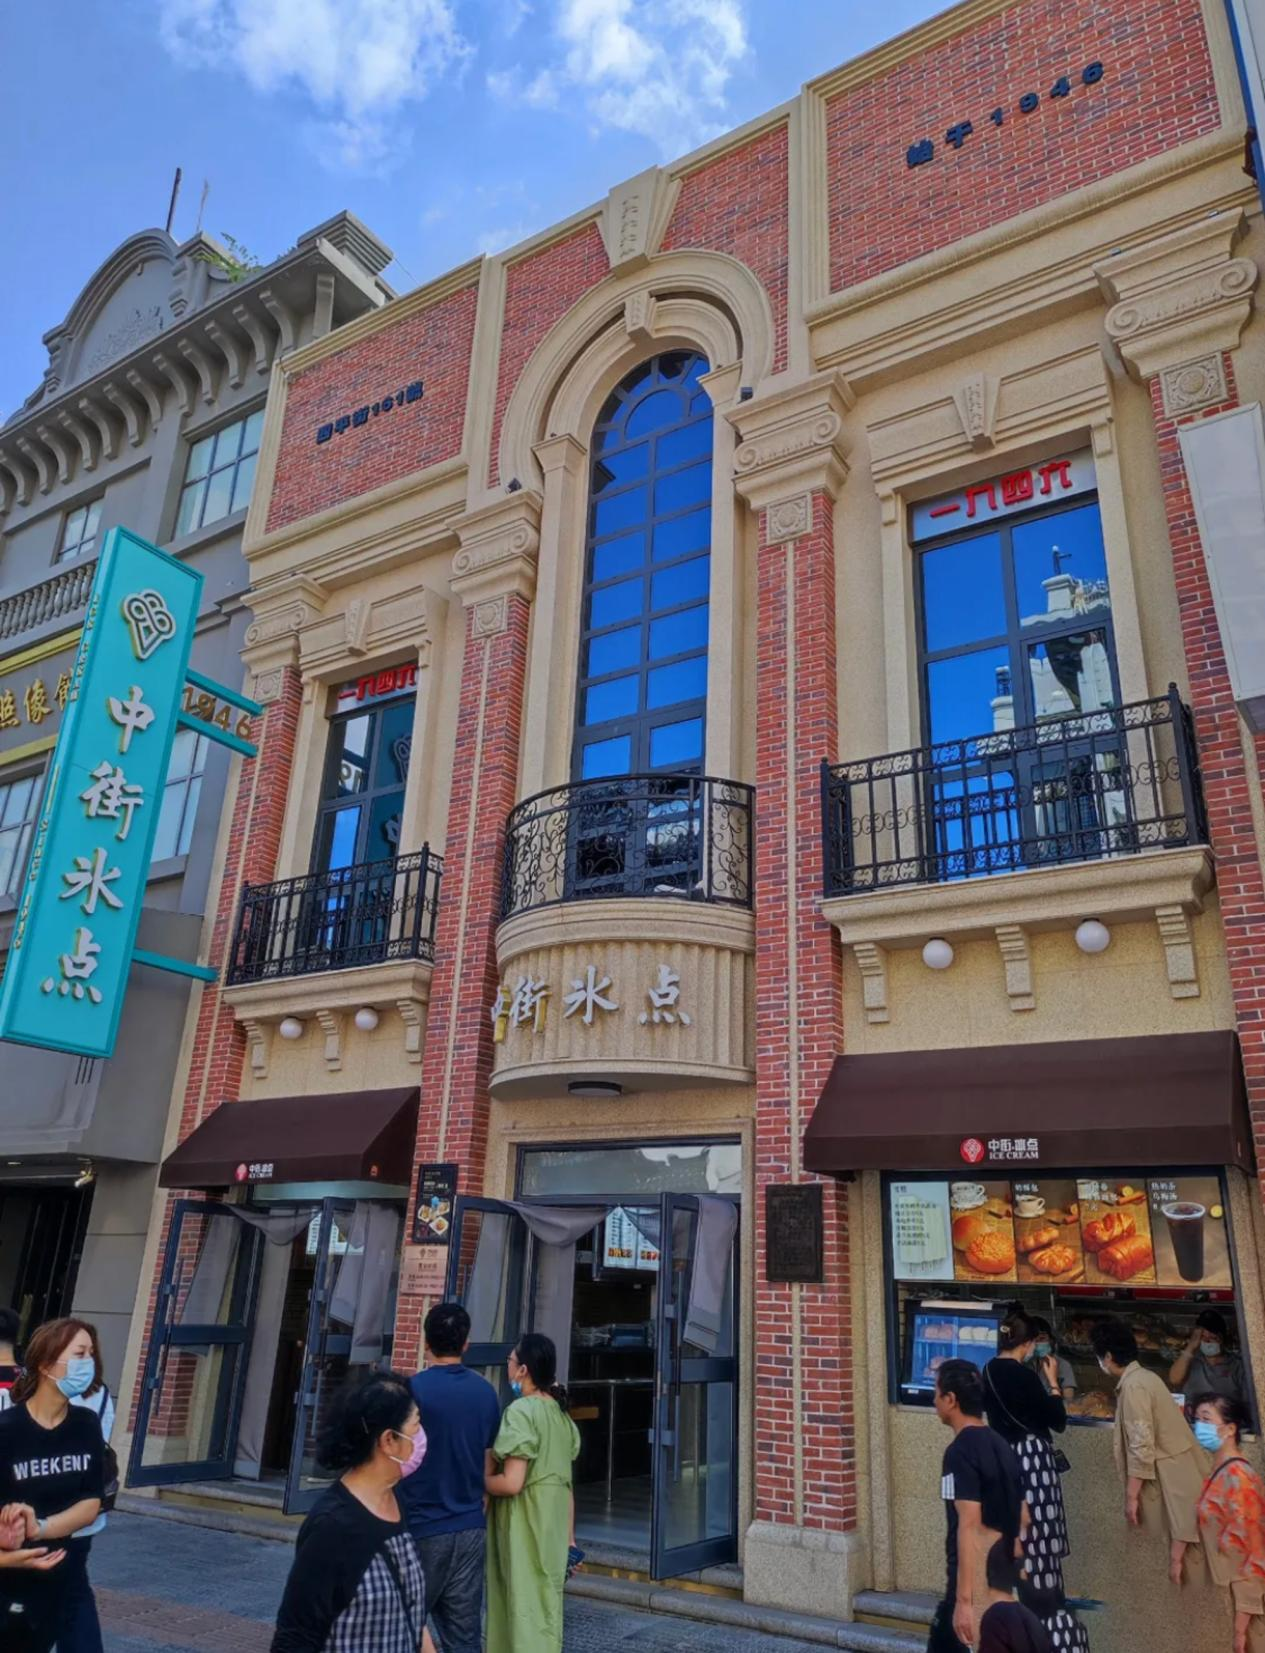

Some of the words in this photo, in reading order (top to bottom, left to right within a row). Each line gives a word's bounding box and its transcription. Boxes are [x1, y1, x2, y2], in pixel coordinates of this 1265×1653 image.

[182, 686, 252, 739] 1946
[989, 1151, 1006, 1160] ICE
[1006, 1151, 1039, 1160] CREAM
